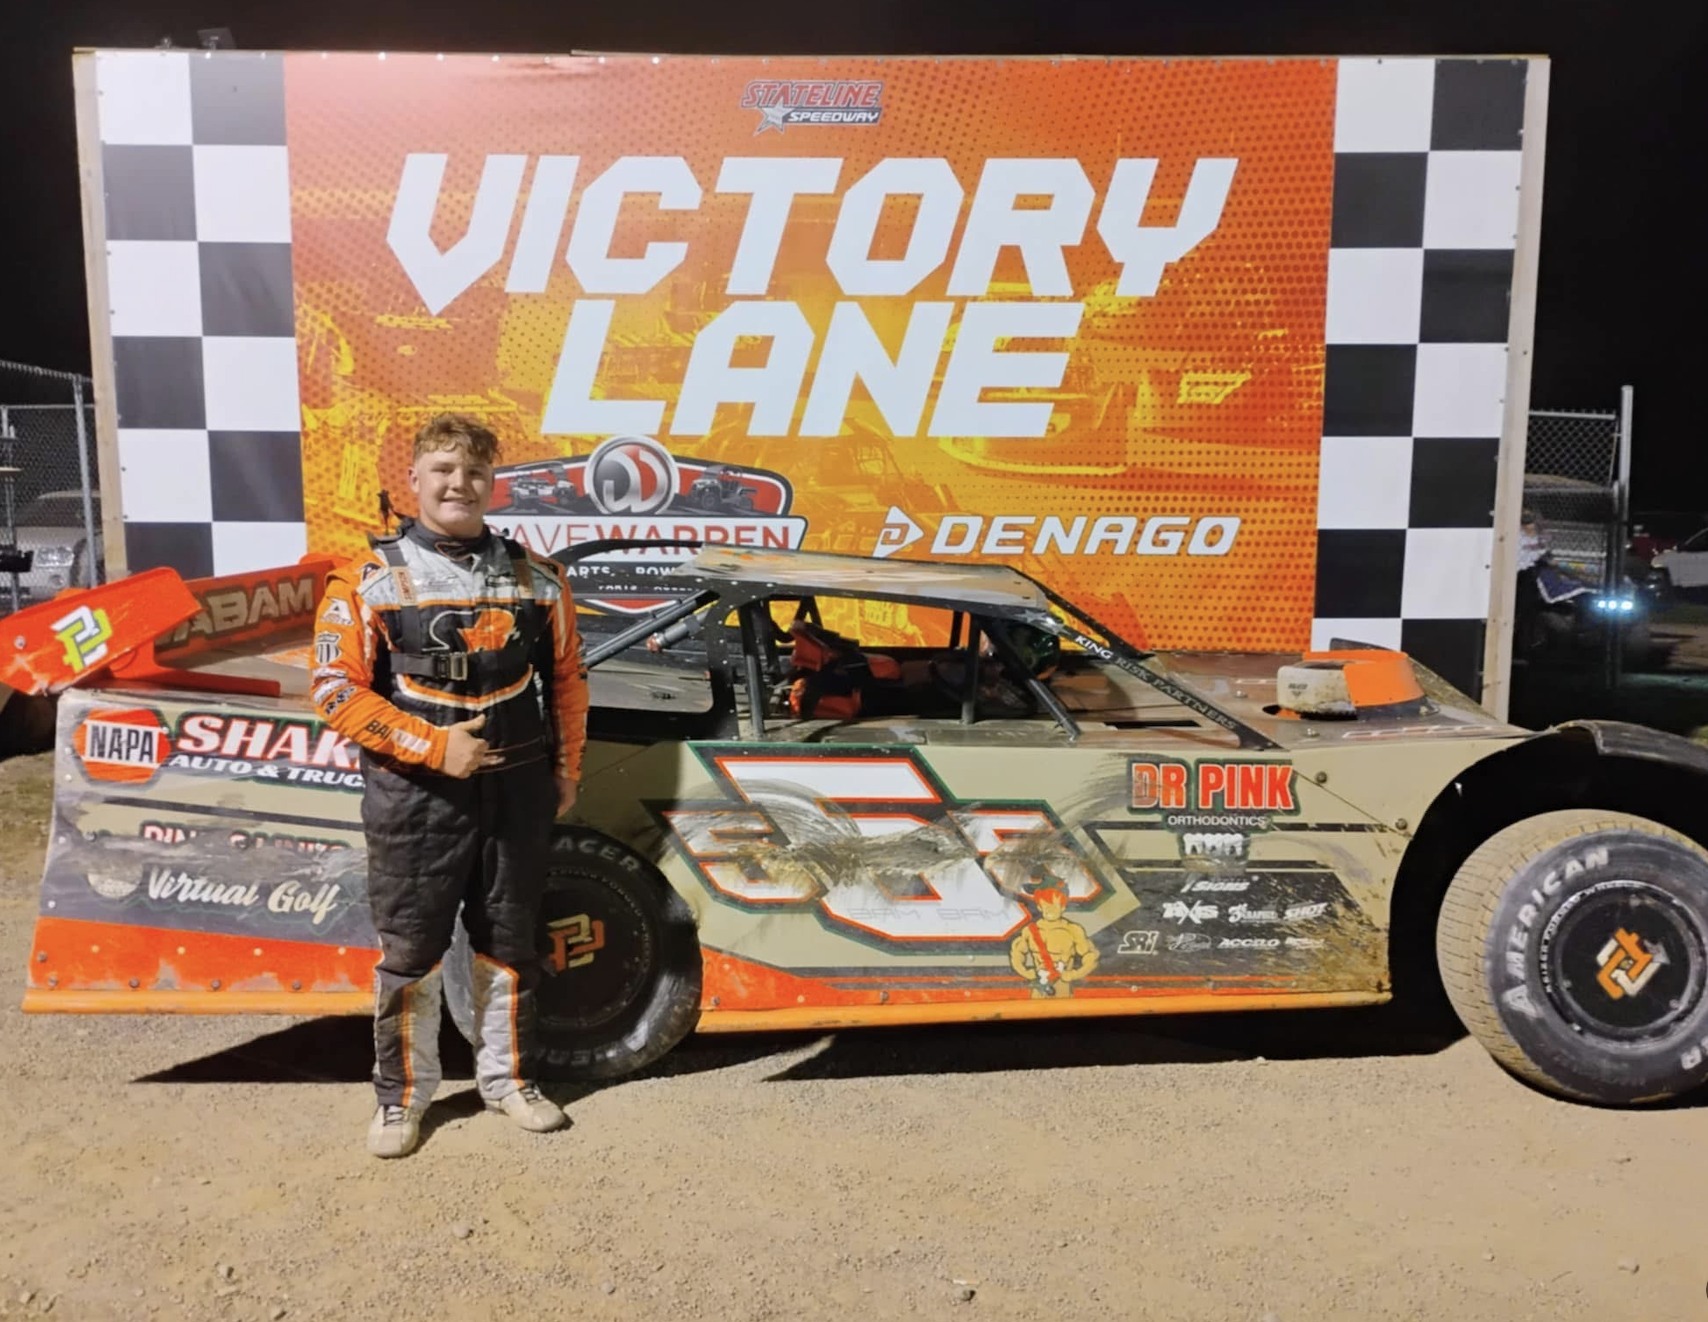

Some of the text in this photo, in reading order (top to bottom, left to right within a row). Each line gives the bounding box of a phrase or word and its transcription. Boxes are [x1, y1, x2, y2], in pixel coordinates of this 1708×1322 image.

[741, 82, 881, 107] STATELINE
[788, 111, 879, 122] SPEEDWAY
[386, 153, 1238, 316] VICTORY
[541, 299, 1086, 437] LANE
[930, 515, 1242, 556] DENAGO
[1075, 635, 1238, 730] KING RISK PARTNERS
[89, 724, 156, 764] NAPA
[176, 712, 360, 771] SHAK
[168, 753, 253, 776] AUTO
[256, 760, 281, 778] &
[1131, 763, 1295, 810] DR PINK
[1167, 815, 1267, 827] ORTHODONTICS
[149, 866, 341, 925] Virtual Golf
[1502, 847, 1610, 1019] AMERICAN
